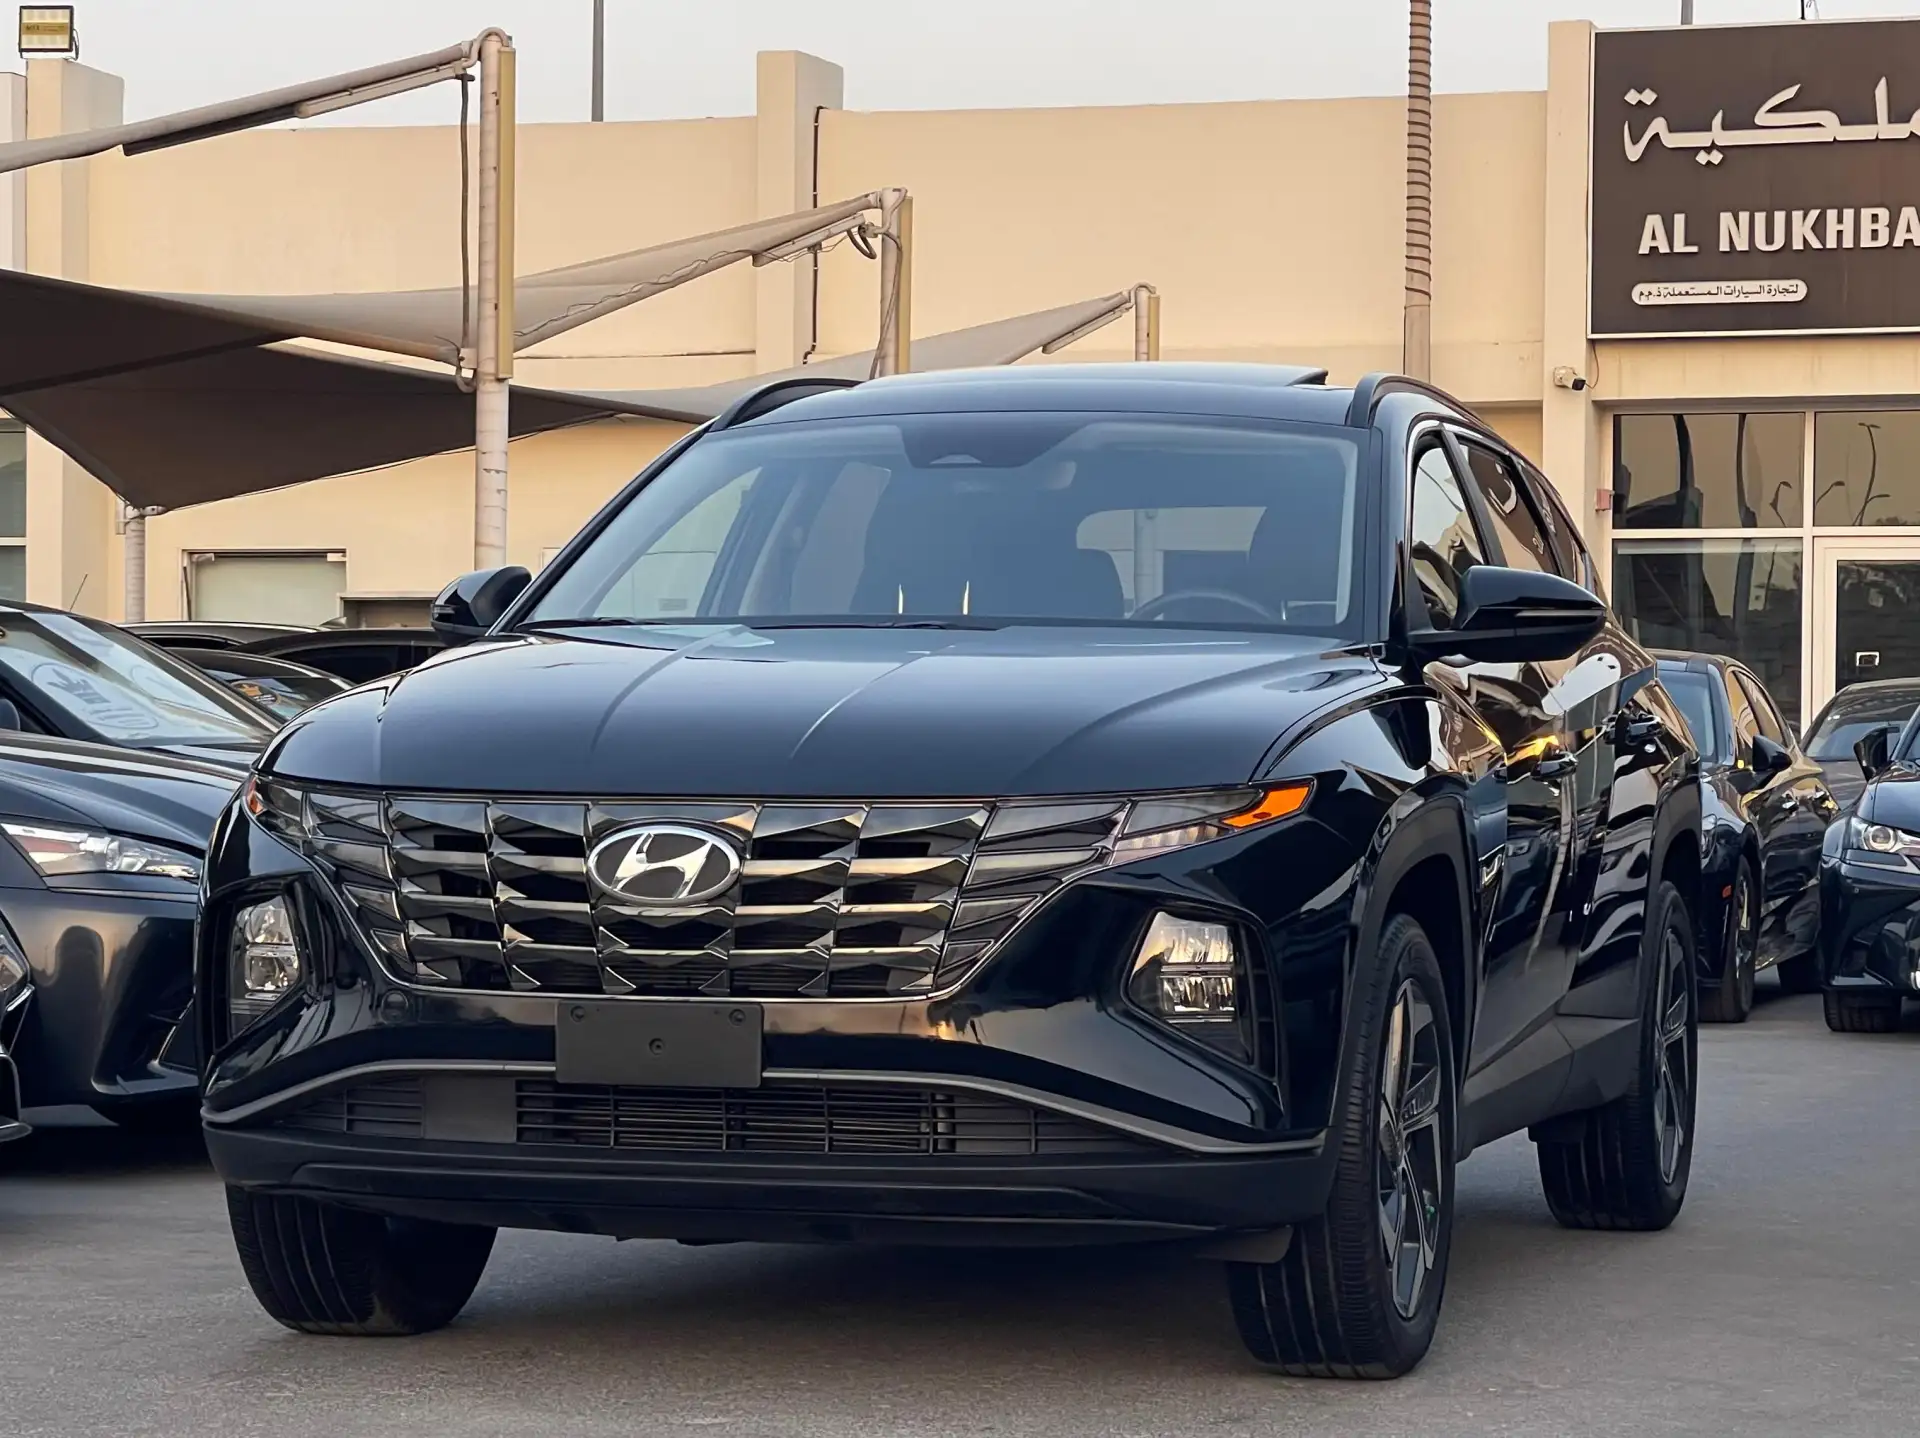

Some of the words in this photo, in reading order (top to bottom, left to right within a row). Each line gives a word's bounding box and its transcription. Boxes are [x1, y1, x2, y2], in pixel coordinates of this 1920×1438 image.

[1638, 213, 1699, 255] AL
[1719, 206, 1920, 252] NUKHBA
[1662, 286, 1722, 299] المستعملة
[1723, 285, 1765, 299] السيارات
[1766, 284, 1799, 297] لتجارة
